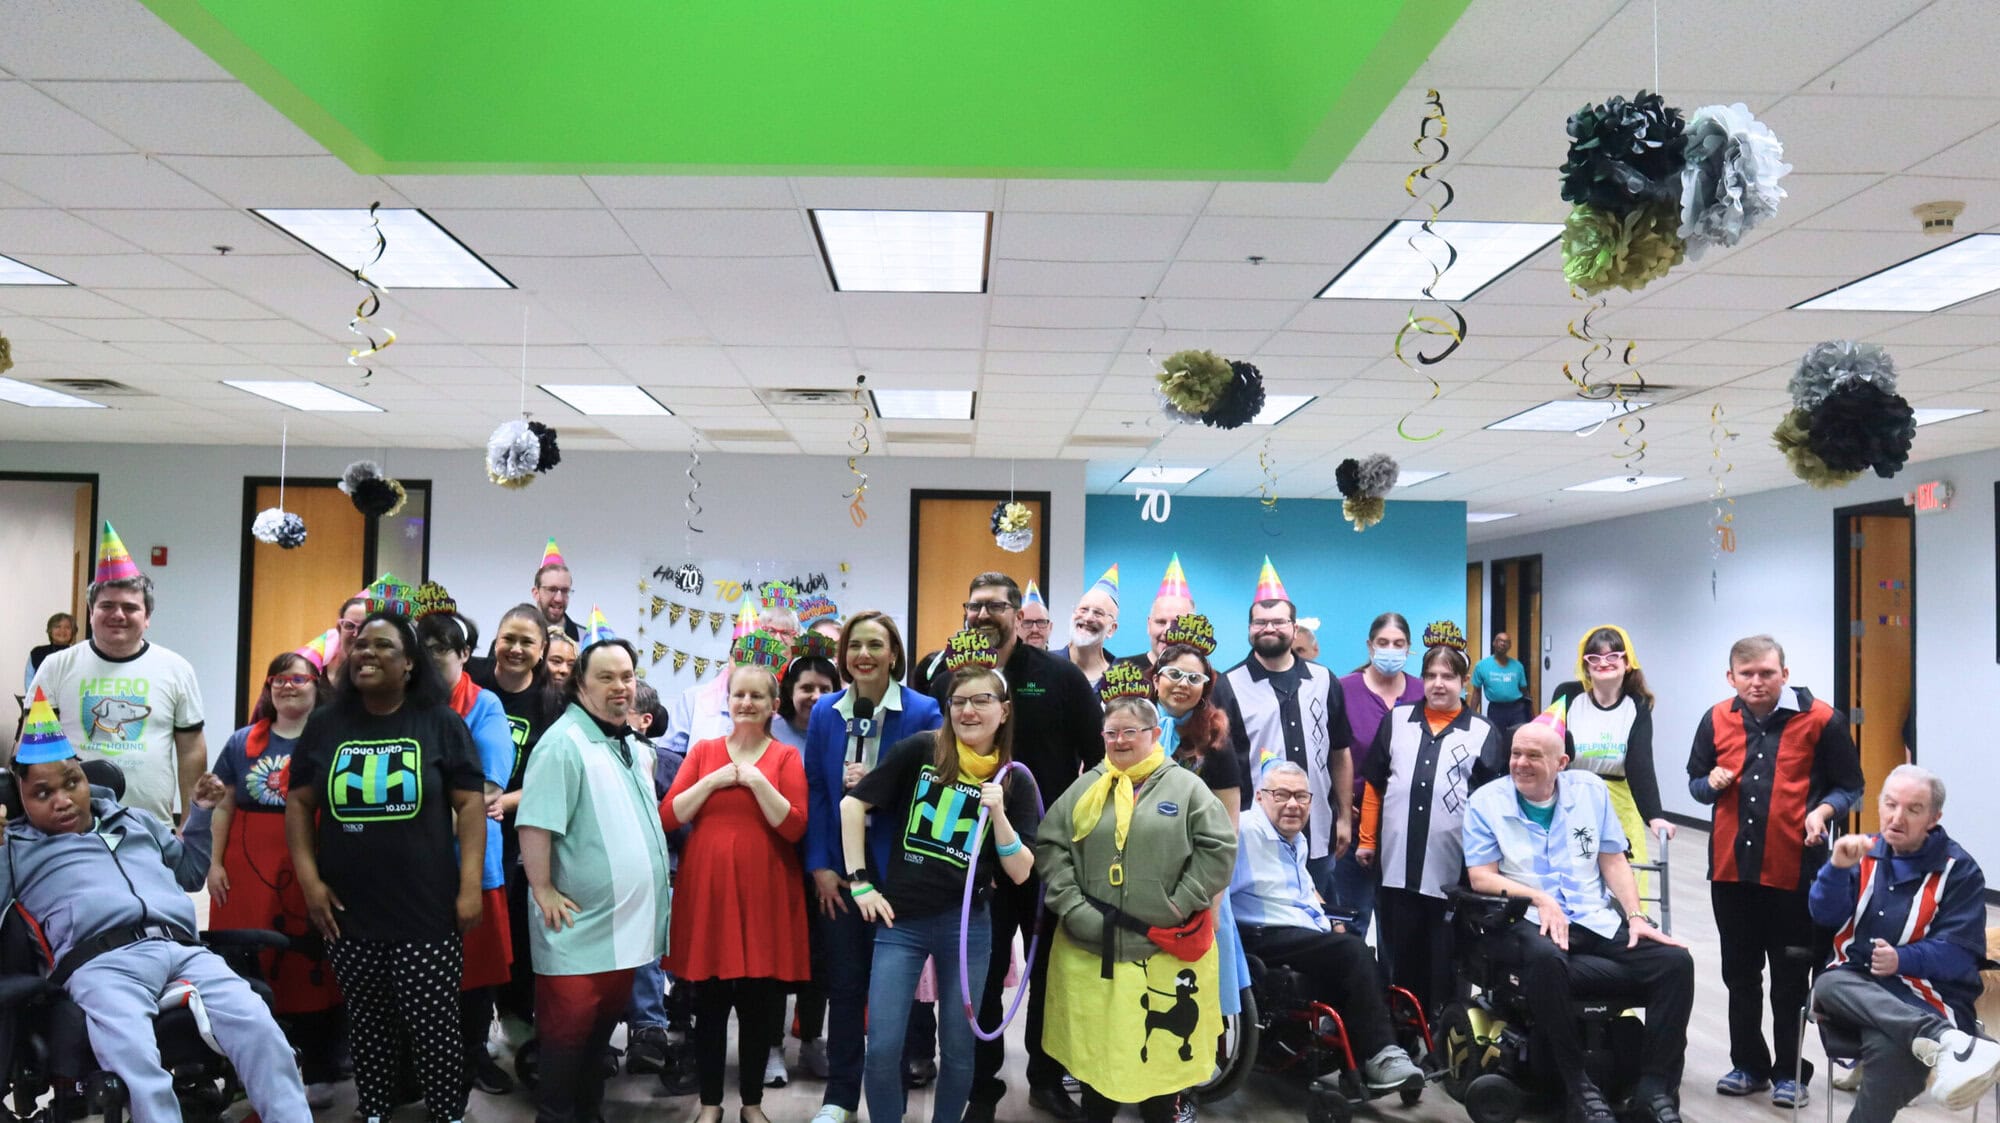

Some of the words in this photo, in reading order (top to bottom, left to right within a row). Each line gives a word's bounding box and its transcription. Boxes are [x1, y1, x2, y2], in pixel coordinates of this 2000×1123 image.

[1135, 488, 1171, 523] 70
[1715, 525, 1736, 553] 70
[680, 569, 699, 588] 70
[80, 677, 149, 696] HERO
[860, 718, 871, 736] 9
